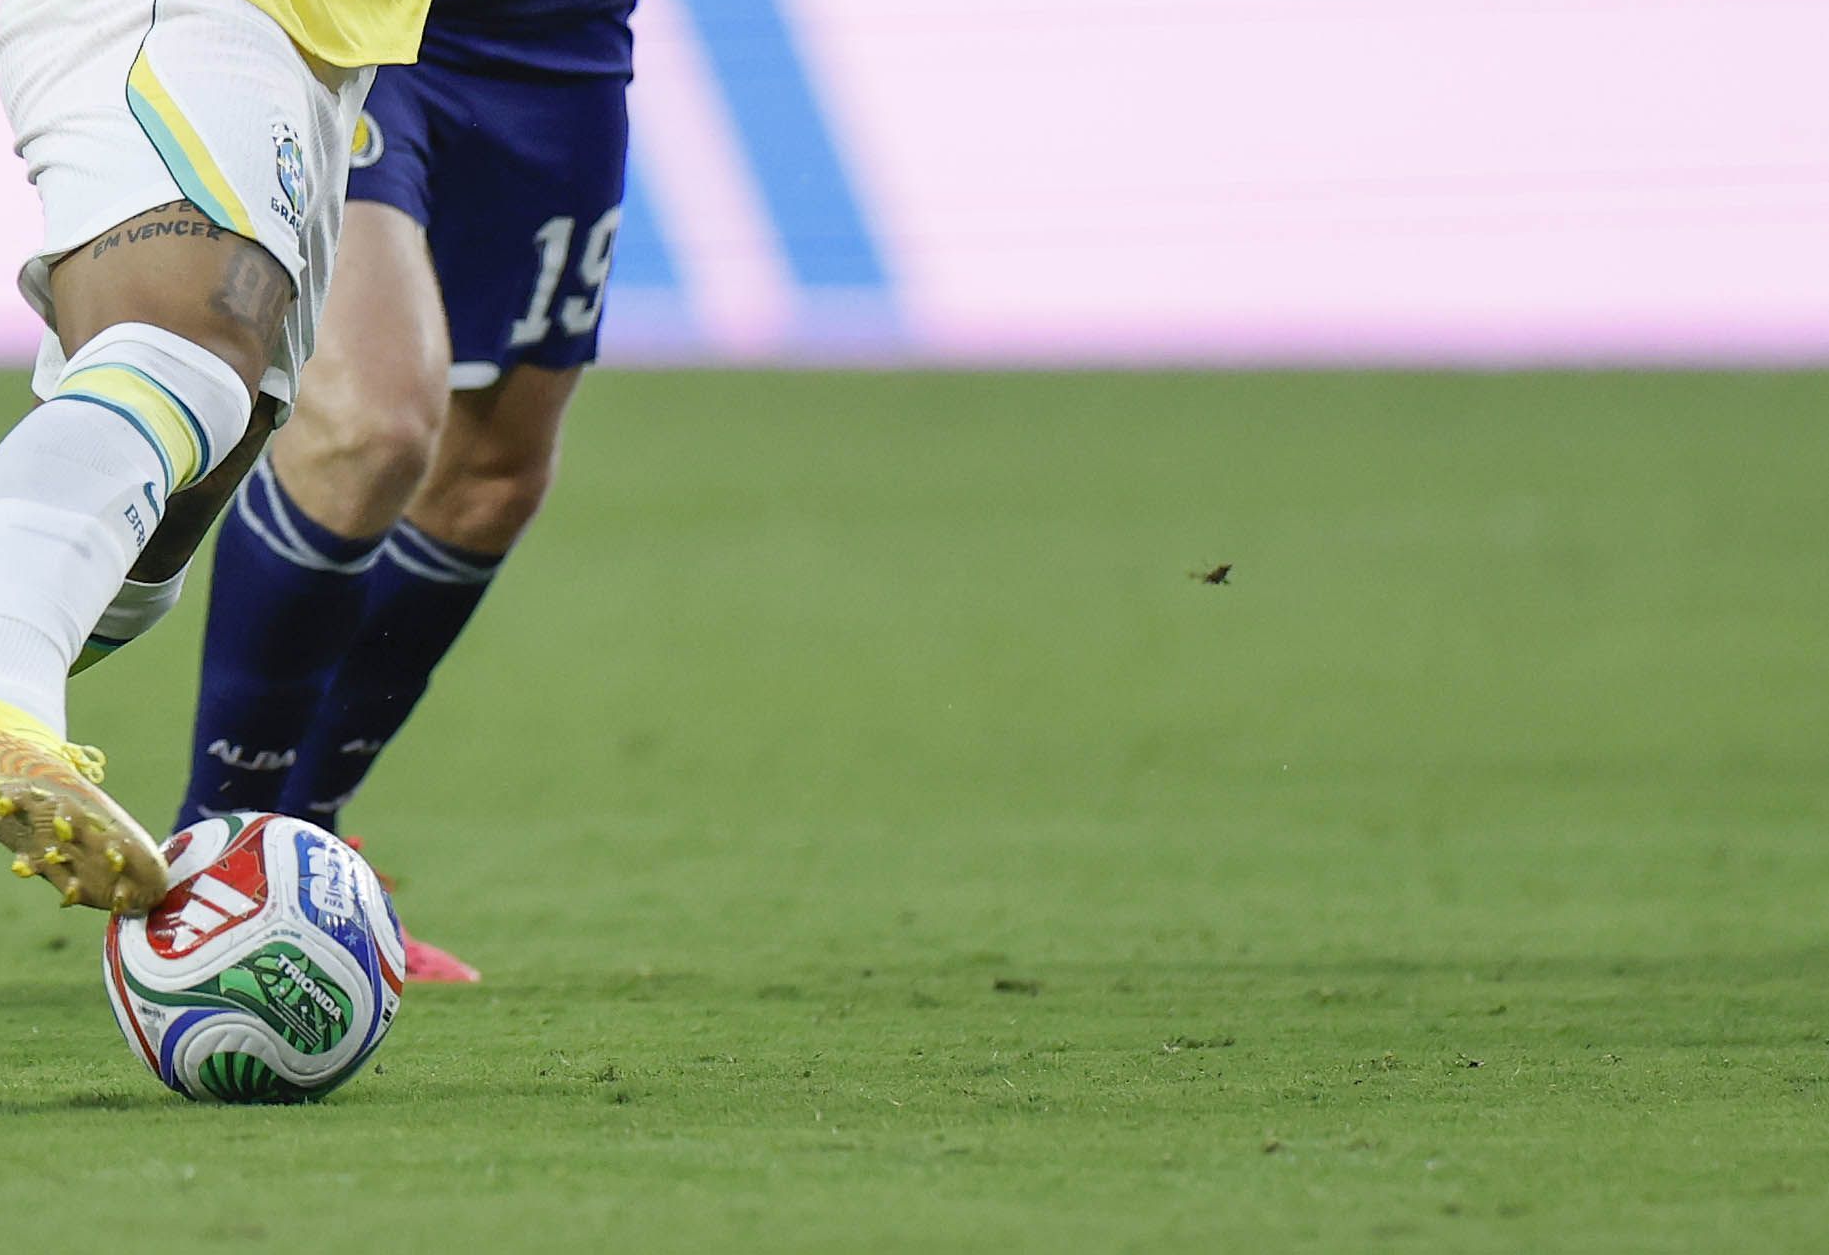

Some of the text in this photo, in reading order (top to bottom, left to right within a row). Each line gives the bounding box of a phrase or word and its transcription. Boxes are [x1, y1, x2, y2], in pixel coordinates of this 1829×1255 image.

[92, 220, 221, 260] EM VENCER
[506, 205, 622, 348] 19
[277, 953, 343, 1022] TRIONDA
